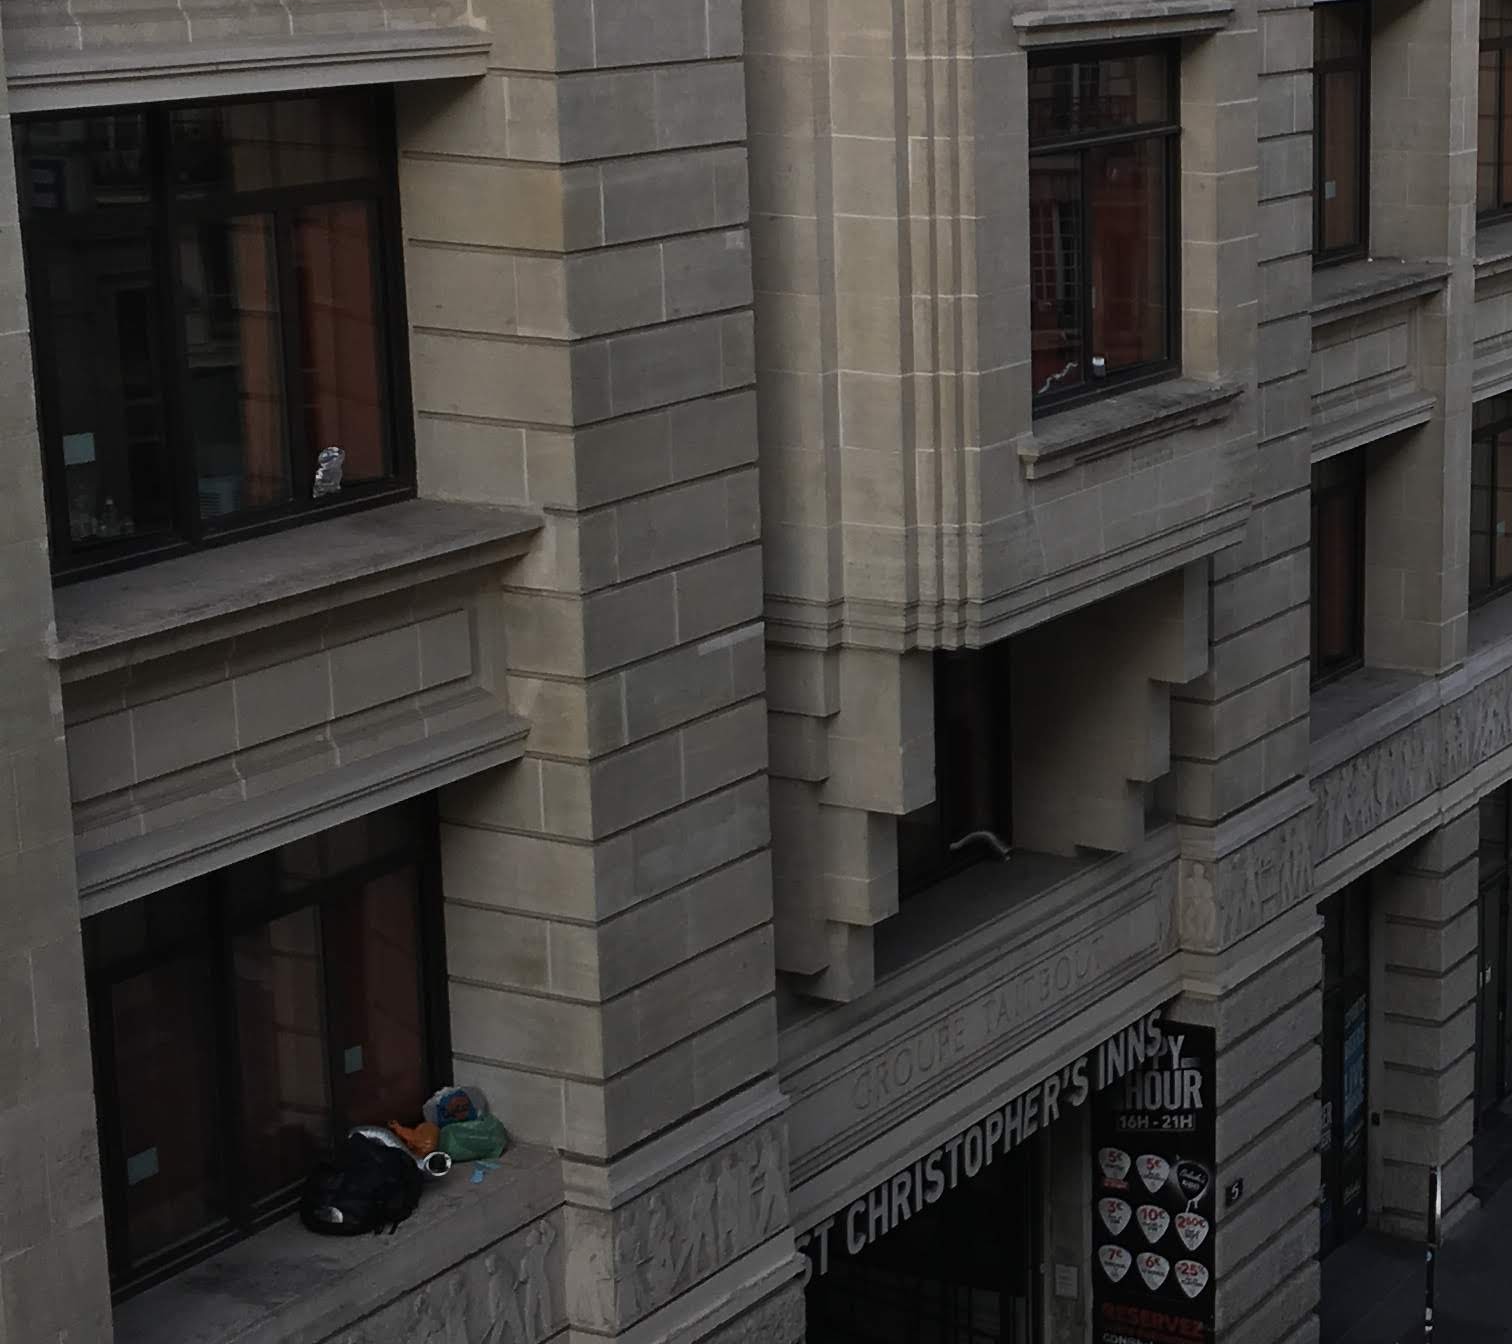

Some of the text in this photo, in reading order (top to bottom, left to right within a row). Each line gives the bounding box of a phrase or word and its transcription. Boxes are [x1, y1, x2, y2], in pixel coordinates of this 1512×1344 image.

[1124, 1069, 1205, 1111] HOUR
[1119, 1114, 1149, 1130] 16H
[1161, 1114, 1194, 1130] 21H
[846, 1056, 1090, 1256] CHRISTOPHER'S
[1097, 1008, 1164, 1091] INNS
[1146, 1157, 1163, 1170] 5€
[1232, 1182, 1240, 1200] 5
[1141, 1208, 1166, 1222] 10€
[1145, 1256, 1161, 1269] 6€
